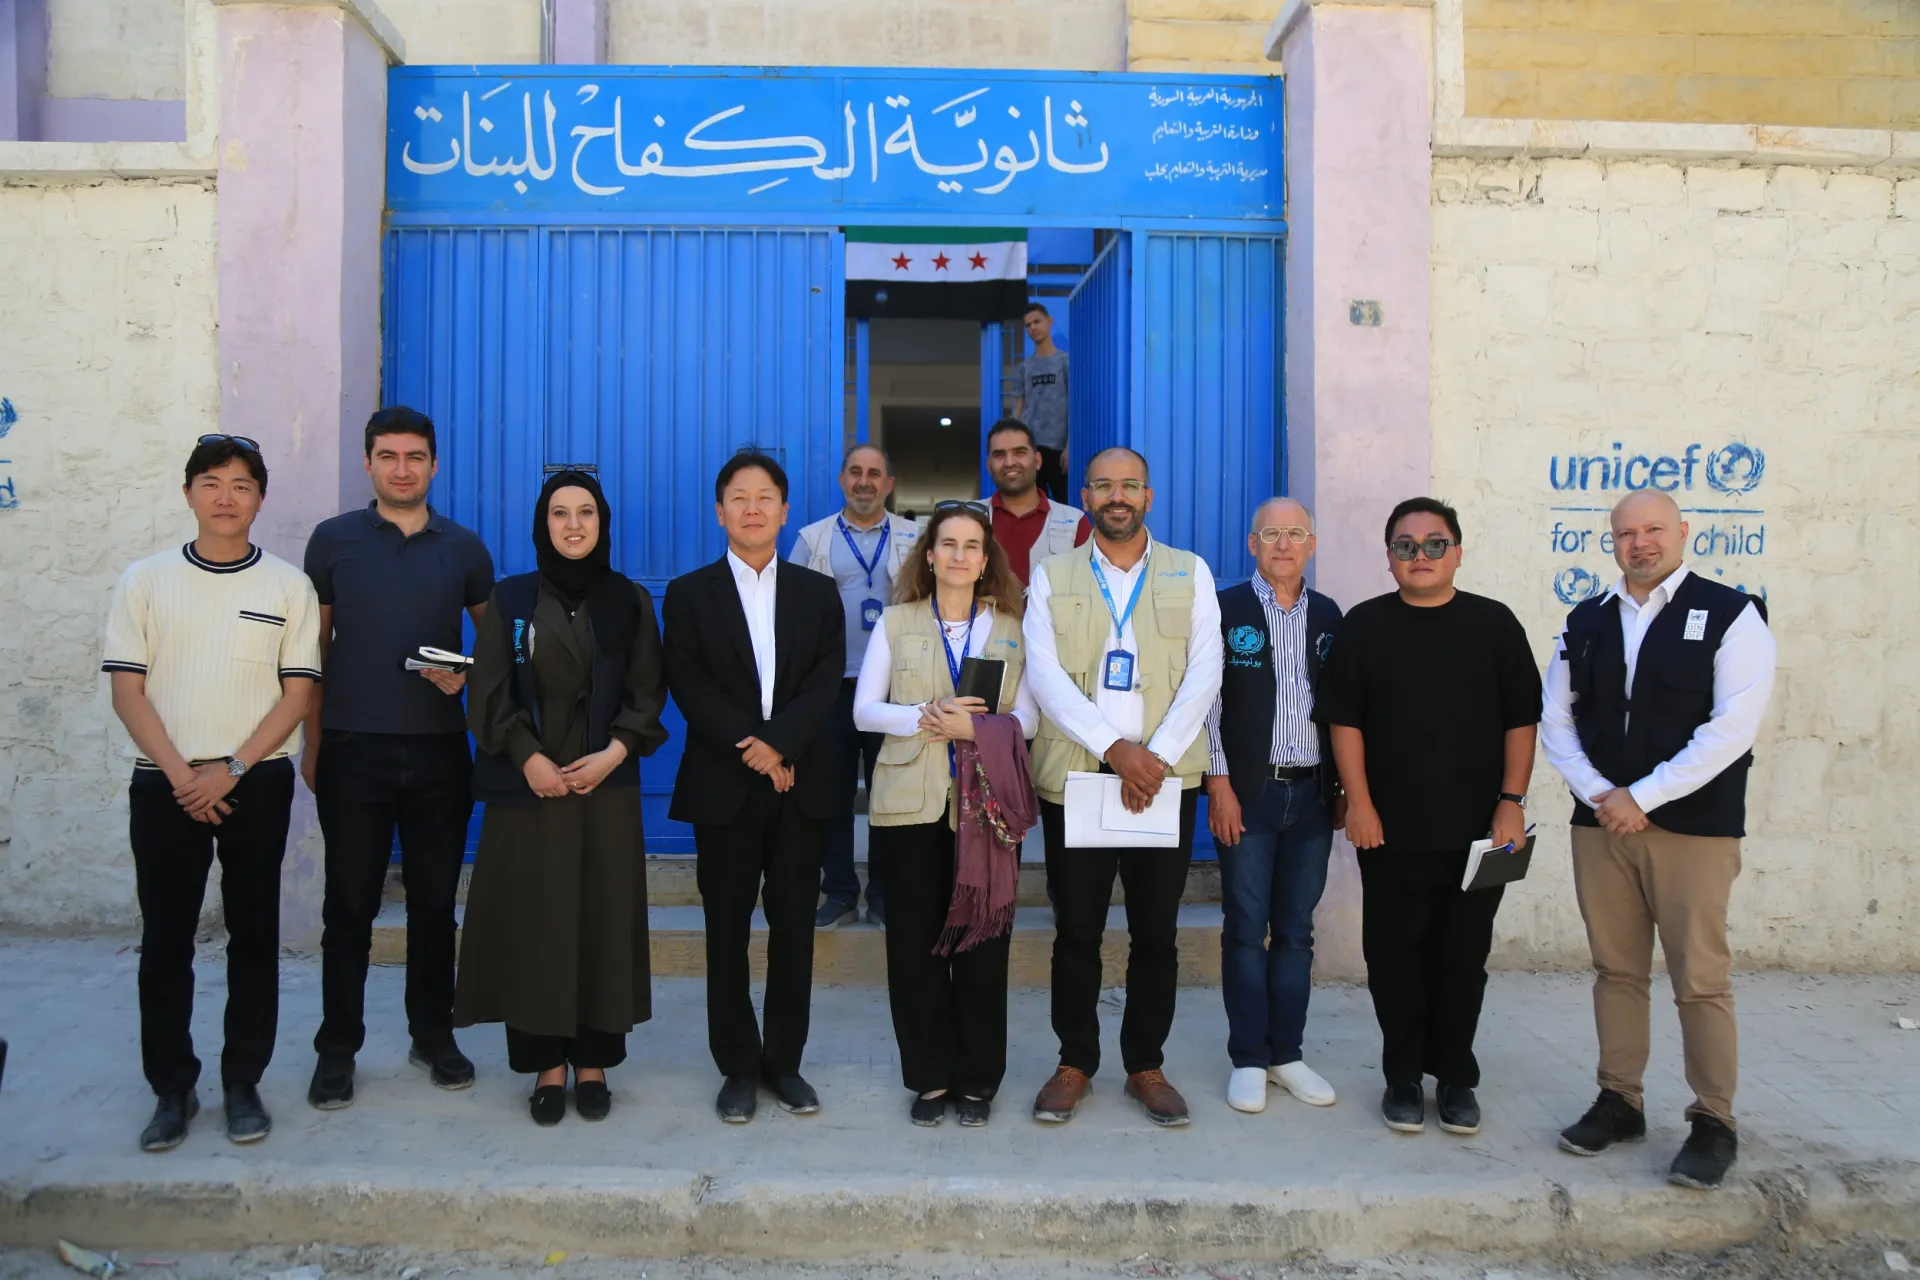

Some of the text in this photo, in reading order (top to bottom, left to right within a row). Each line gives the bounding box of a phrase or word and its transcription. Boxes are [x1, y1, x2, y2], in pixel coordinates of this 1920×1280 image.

[1148, 85, 1184, 108] السورية
[1187, 86, 1219, 107] العربية
[1152, 120, 1260, 145] وزارة التربية والتعليم
[1144, 160, 1269, 184] مديرية التربية والتعليم بحلب
[1549, 441, 1703, 492] unicef
[1551, 522, 1593, 553] for
[1693, 524, 1765, 556] child
